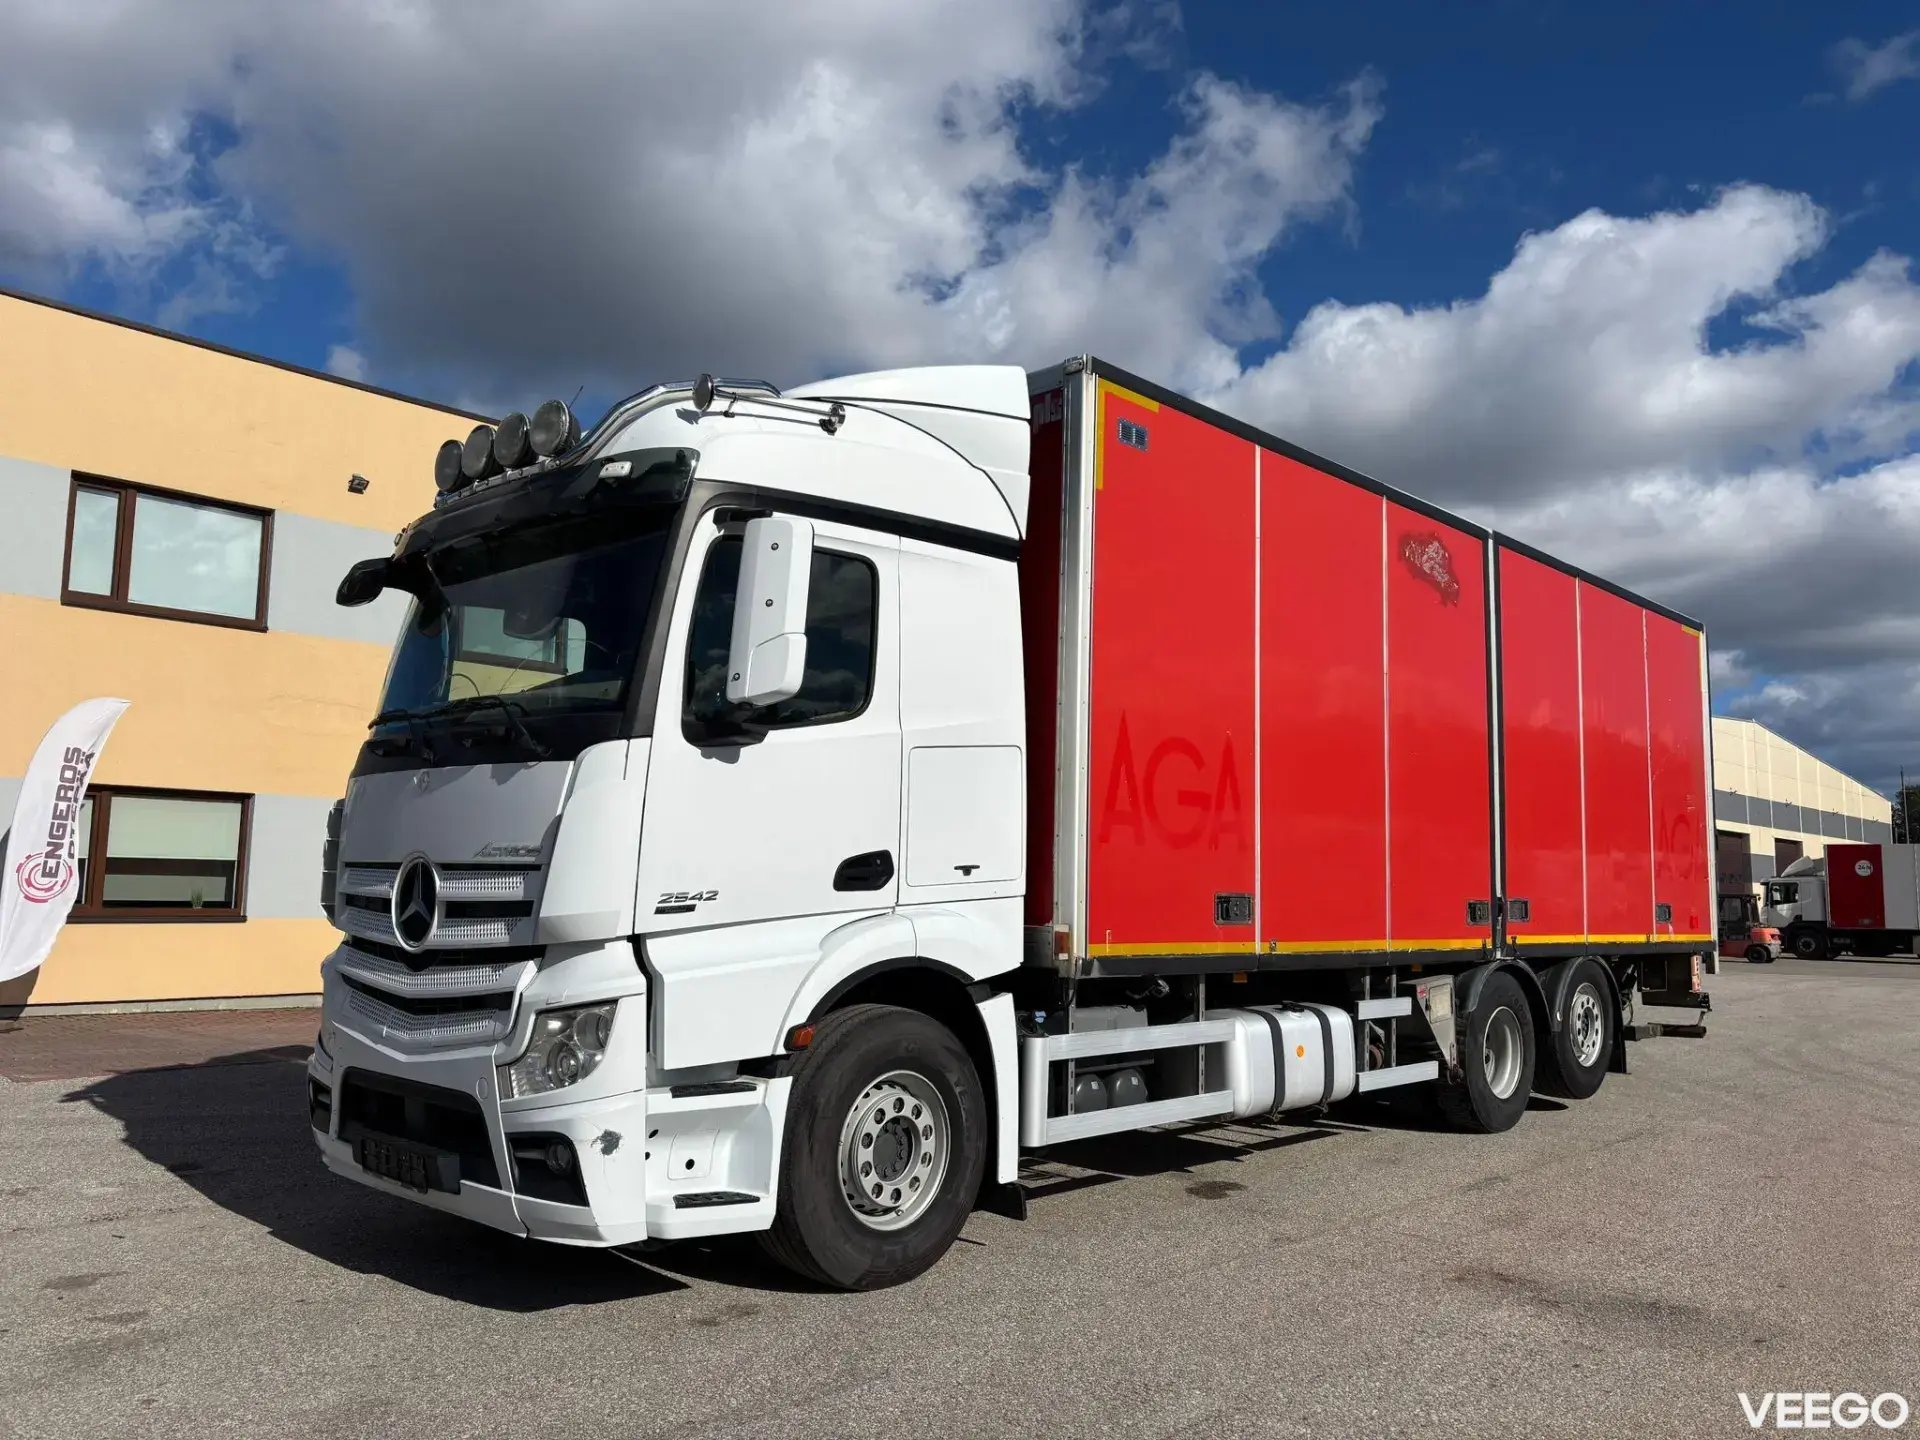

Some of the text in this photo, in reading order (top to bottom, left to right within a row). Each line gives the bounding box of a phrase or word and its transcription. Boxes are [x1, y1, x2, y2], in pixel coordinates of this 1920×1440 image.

[41, 746, 82, 879] ENGEROS
[1098, 708, 1248, 852] AGA
[657, 890, 719, 904] 2542
